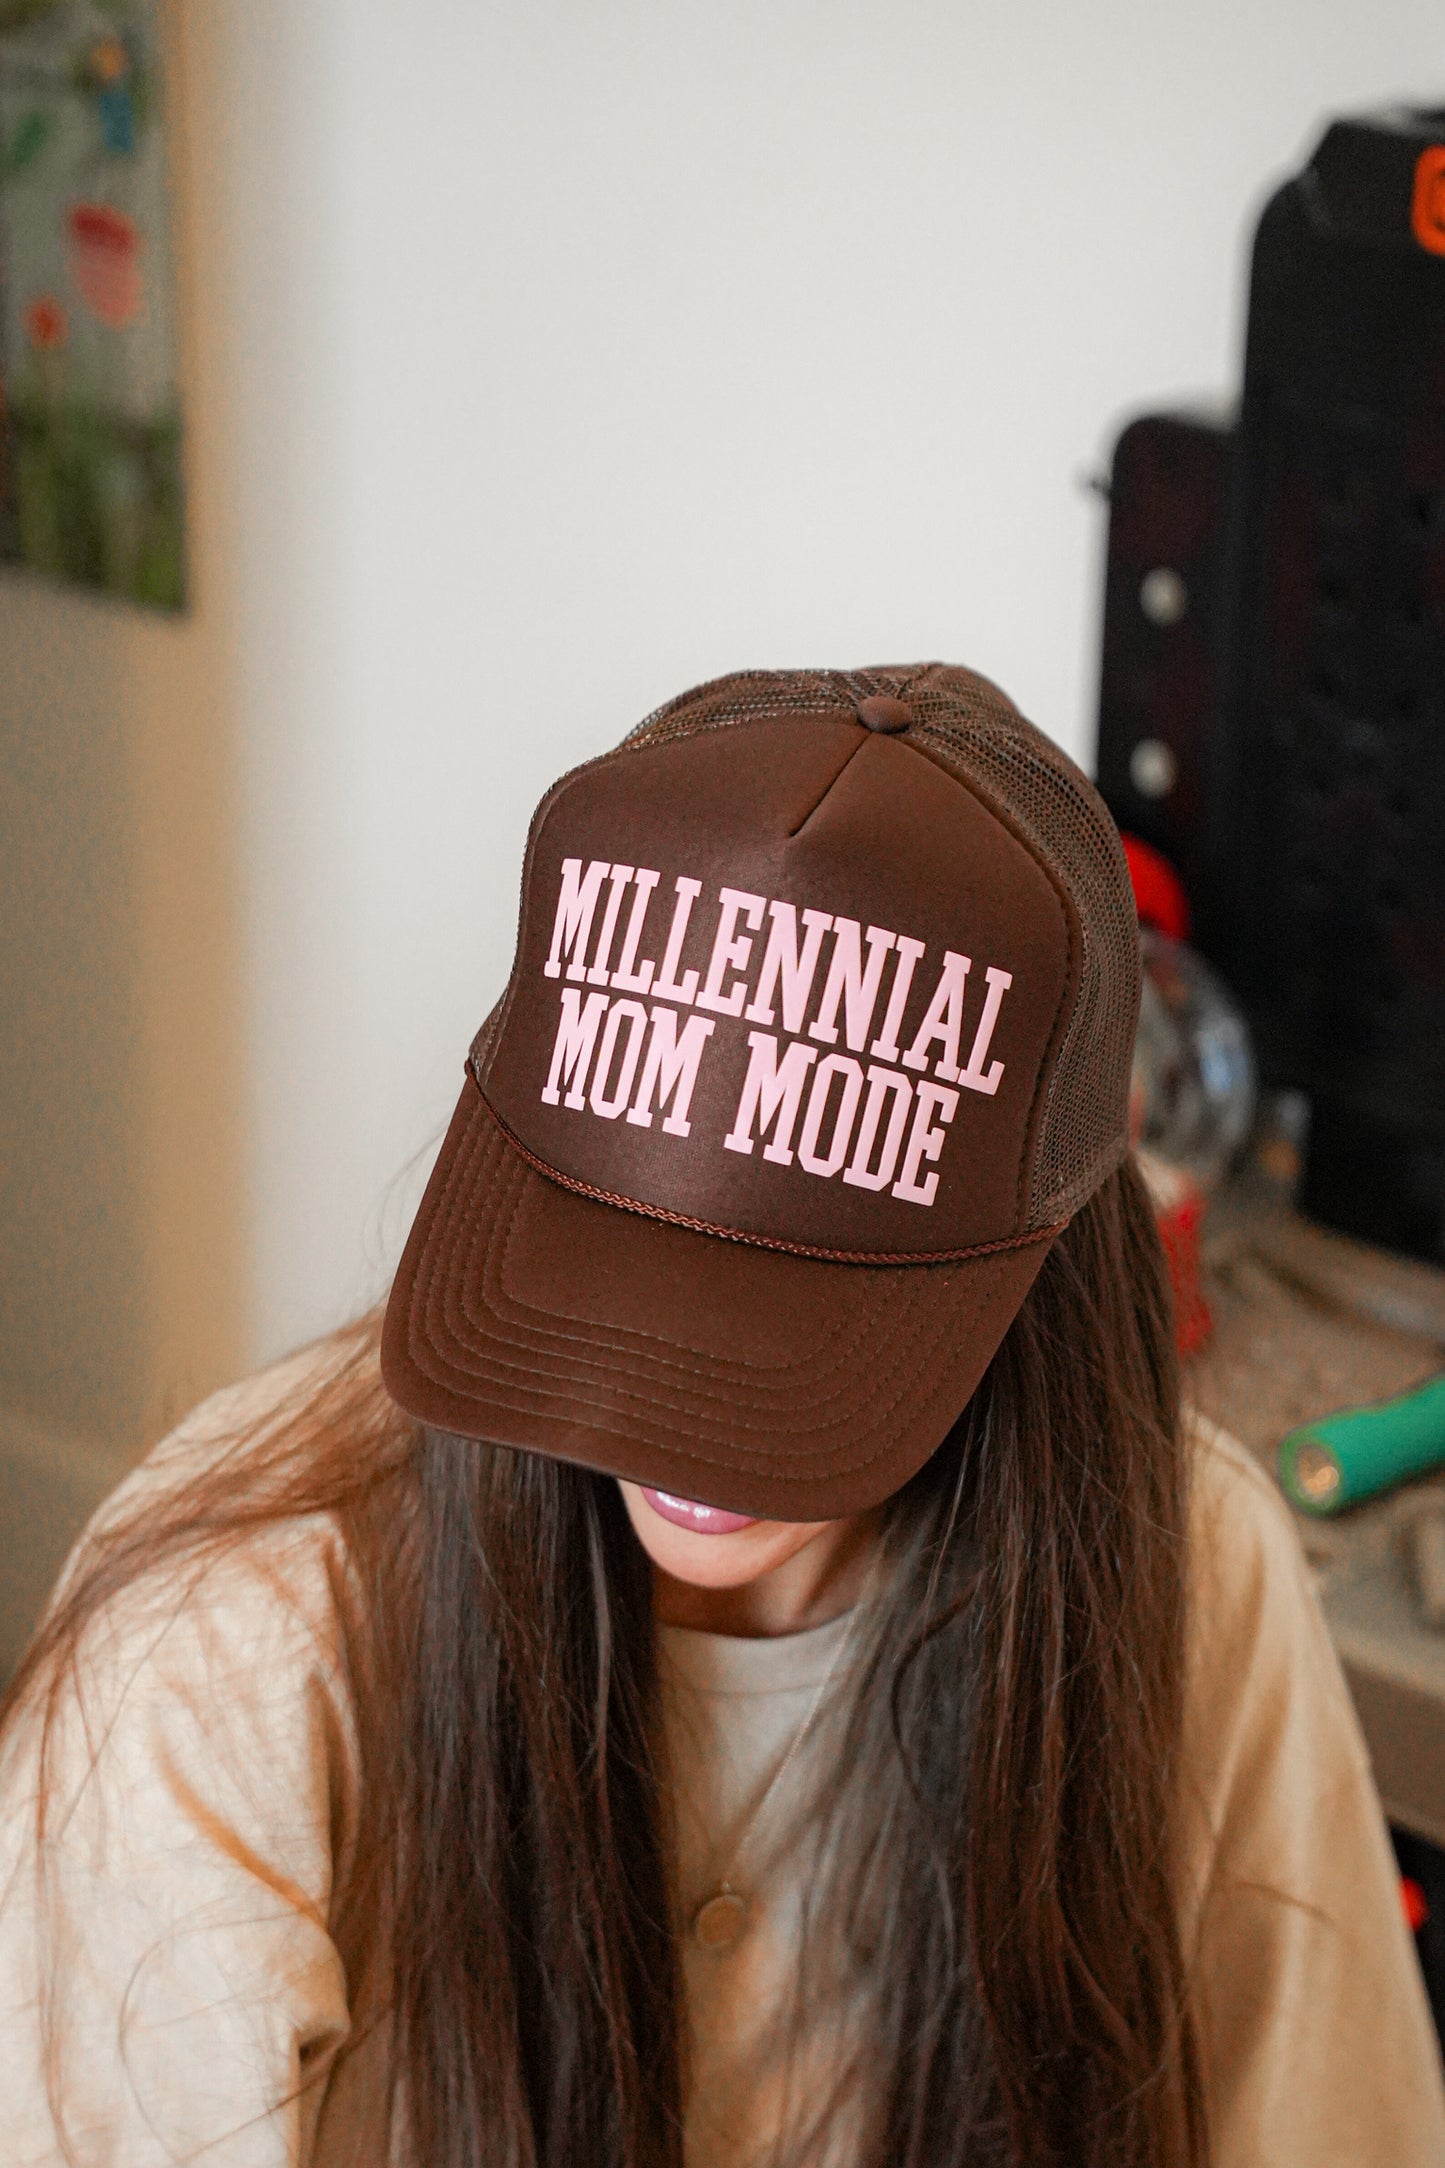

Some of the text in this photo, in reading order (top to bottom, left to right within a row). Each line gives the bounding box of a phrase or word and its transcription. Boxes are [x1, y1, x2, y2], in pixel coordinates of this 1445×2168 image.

[543, 857, 1013, 1096] MILLENNIAL
[540, 987, 960, 1207] MOM MODE
